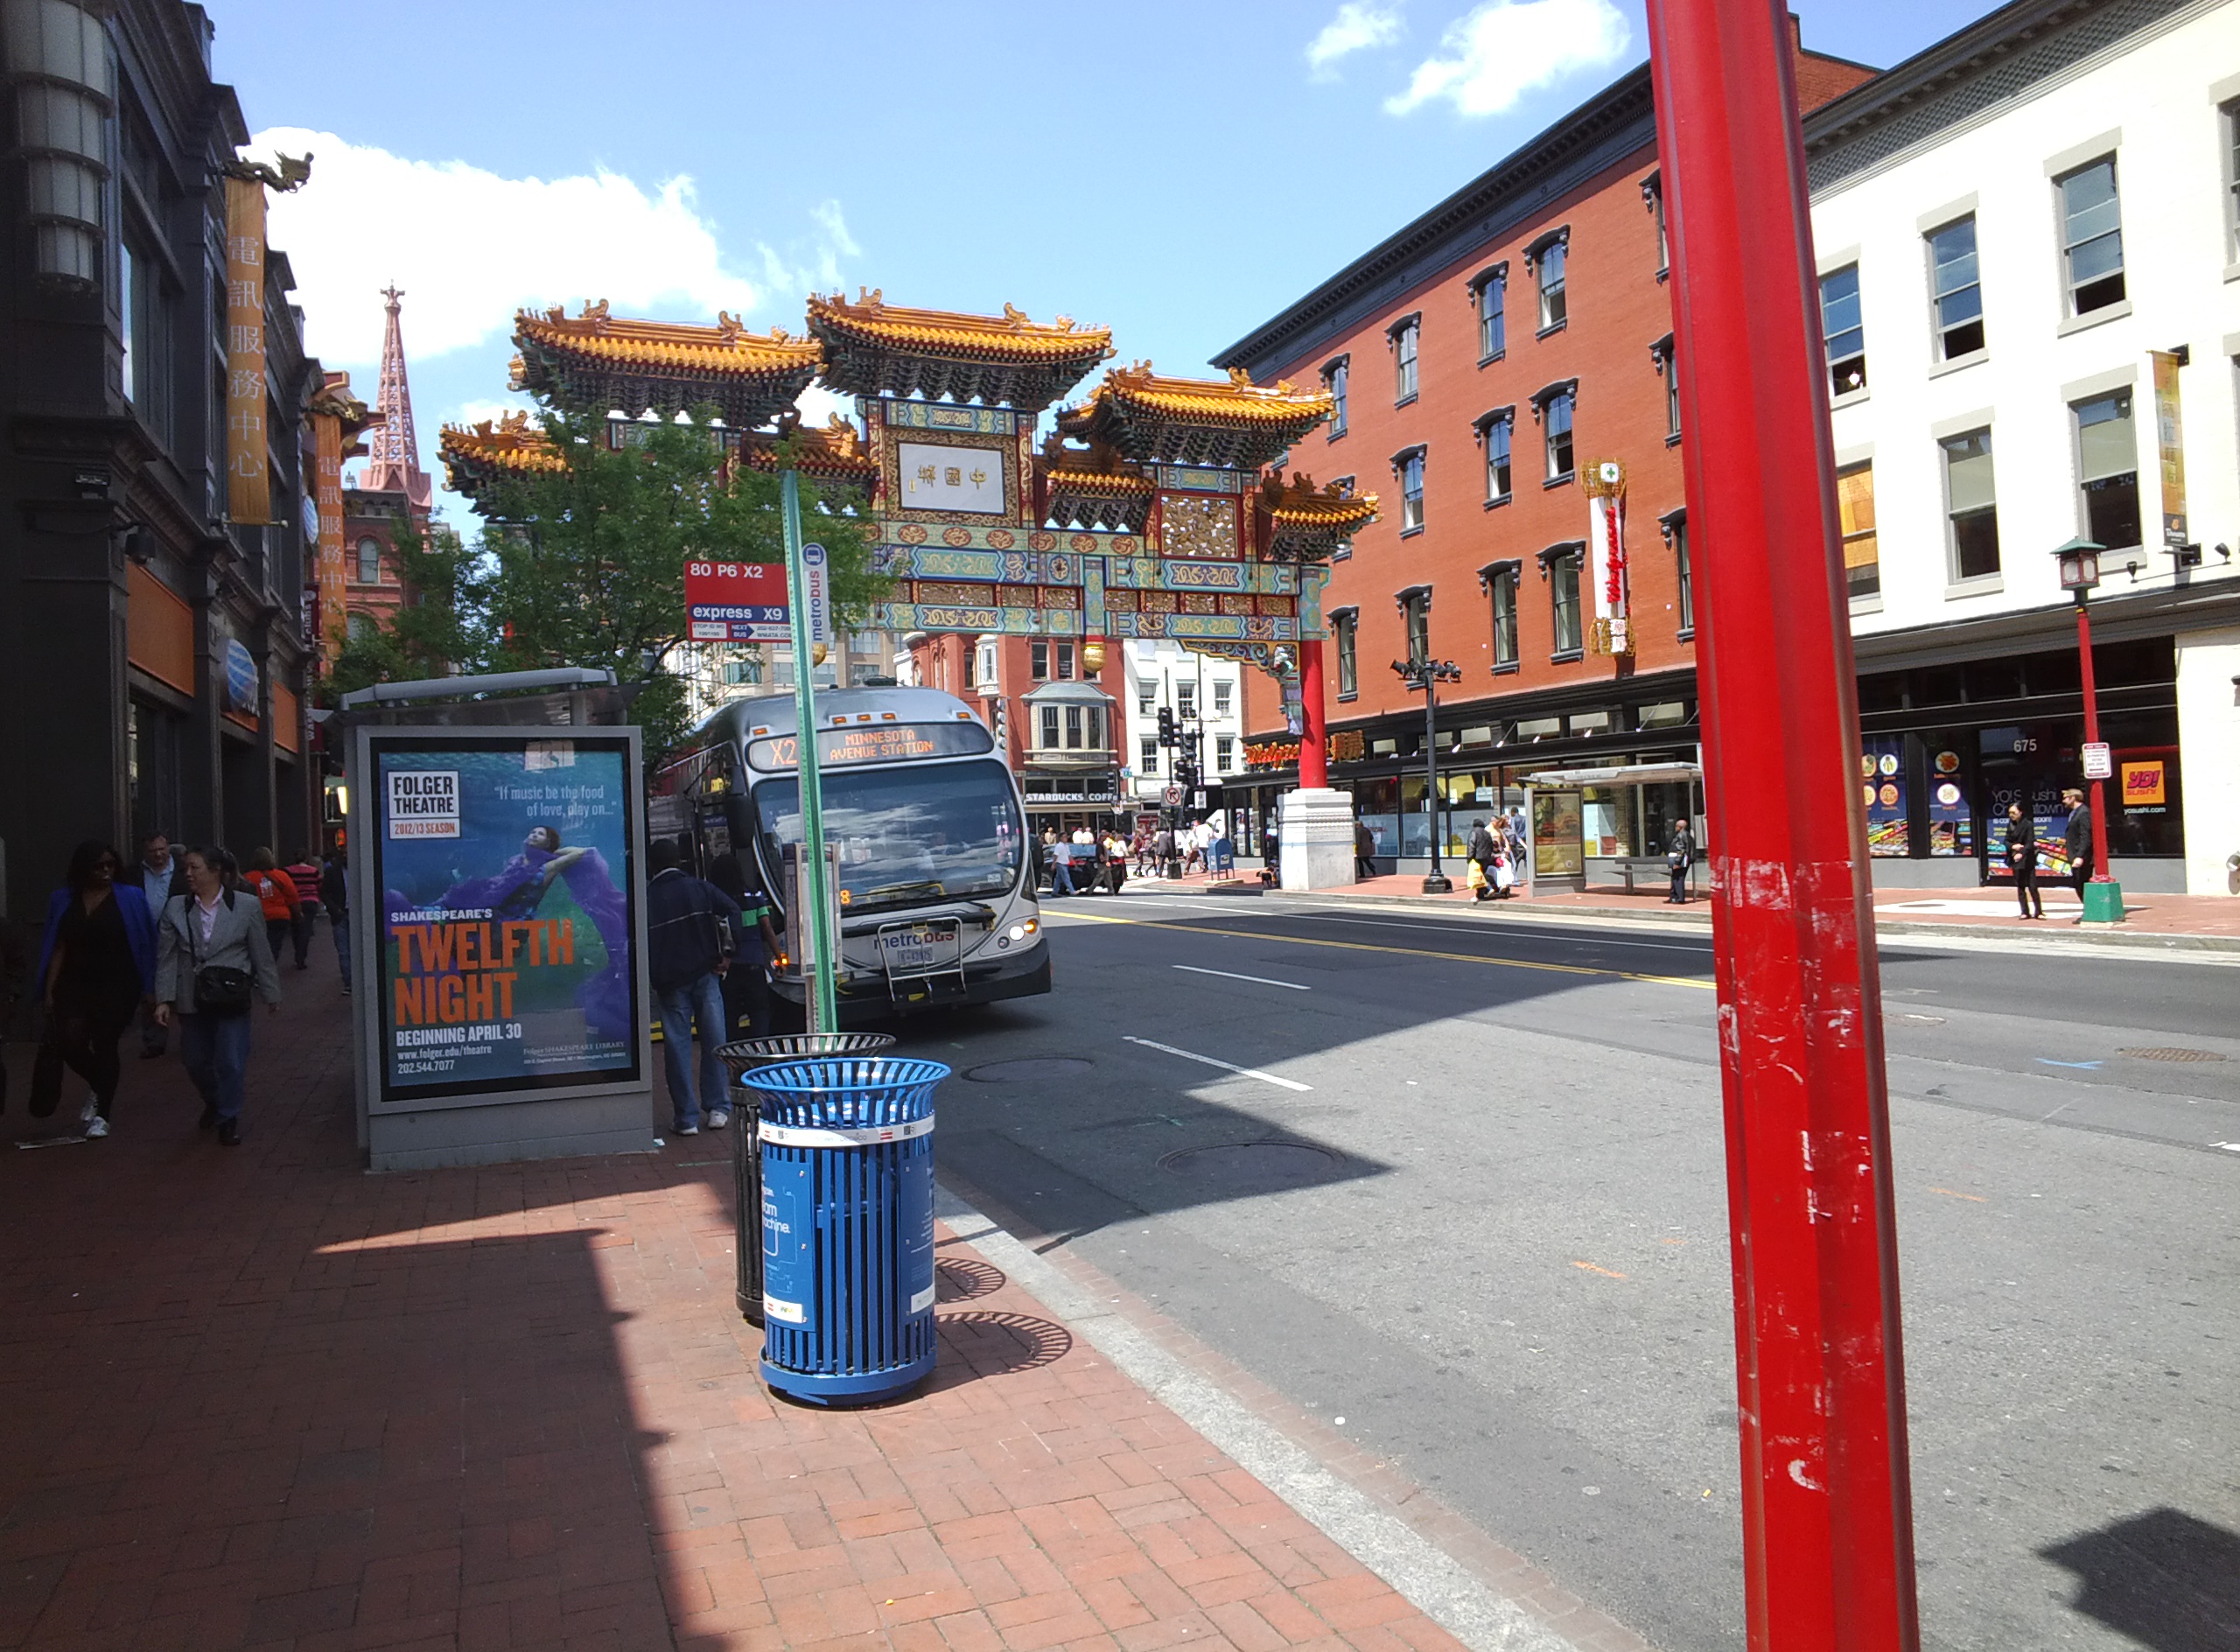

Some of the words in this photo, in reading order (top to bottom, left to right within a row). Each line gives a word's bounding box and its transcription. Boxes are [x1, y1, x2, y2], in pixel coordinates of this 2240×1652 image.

[228, 236, 262, 477] 電訊服務中心
[318, 456, 344, 614] 電訊服務中心
[690, 564, 711, 577] 80
[718, 564, 738, 578] P6
[743, 565, 763, 578] X2
[693, 606, 752, 620] express
[763, 607, 782, 620] X9
[809, 570, 822, 641] metrobus
[844, 729, 915, 746] MINNESOTA
[2013, 738, 2037, 752] 675
[769, 739, 798, 766] X2
[830, 746, 877, 760] AVENUE
[881, 740, 934, 757] STATION
[394, 776, 453, 795] FOLGER
[2127, 770, 2160, 788] YO!
[511, 786, 543, 800] music
[546, 786, 558, 799] be
[561, 785, 578, 799] the
[581, 785, 604, 799] food
[1026, 793, 1084, 802] STARBUCKS
[1992, 790, 2012, 803] YO!
[394, 797, 454, 814] THEATRE
[527, 802, 537, 816] of
[540, 802, 566, 817] love,
[567, 802, 589, 818] play
[2124, 806, 2166, 816] yosushi.com
[395, 823, 424, 835] 2012/13
[426, 822, 455, 834] SEASON
[391, 908, 493, 922] SHAKESPEARE'S
[391, 918, 574, 974] TWELFTH
[874, 932, 955, 950] metrobus
[396, 971, 518, 1026] NIGHT
[396, 1027, 466, 1046] BEGINNING
[467, 1025, 504, 1041] APRIL
[506, 1023, 522, 1039] 30
[397, 1045, 492, 1060] www.folger.edu/theatre
[397, 1060, 455, 1074] 202.544.7077
